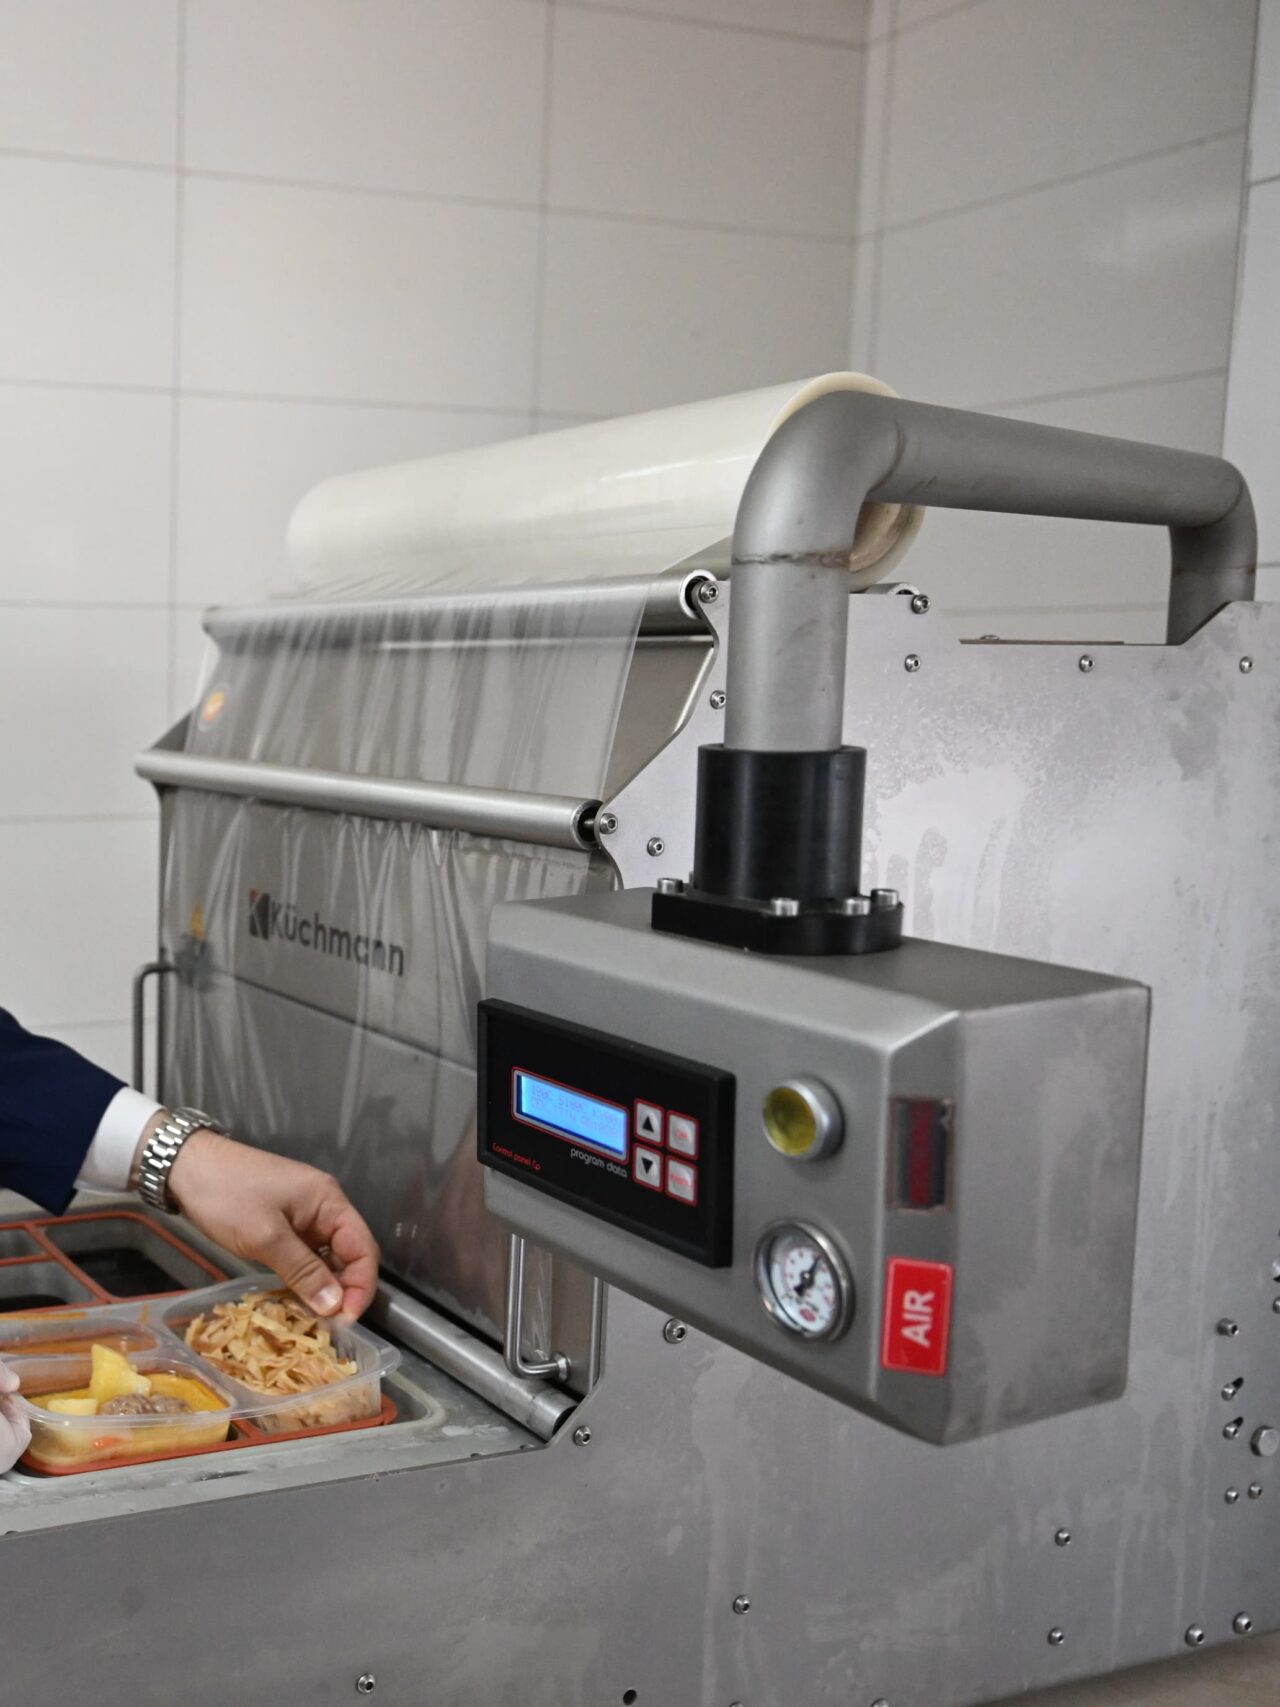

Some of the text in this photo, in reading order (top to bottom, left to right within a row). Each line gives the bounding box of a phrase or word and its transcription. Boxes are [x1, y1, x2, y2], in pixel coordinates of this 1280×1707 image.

[272, 900, 405, 977] Küchmann
[570, 1147, 628, 1178] program data
[901, 1289, 936, 1349] AIR
